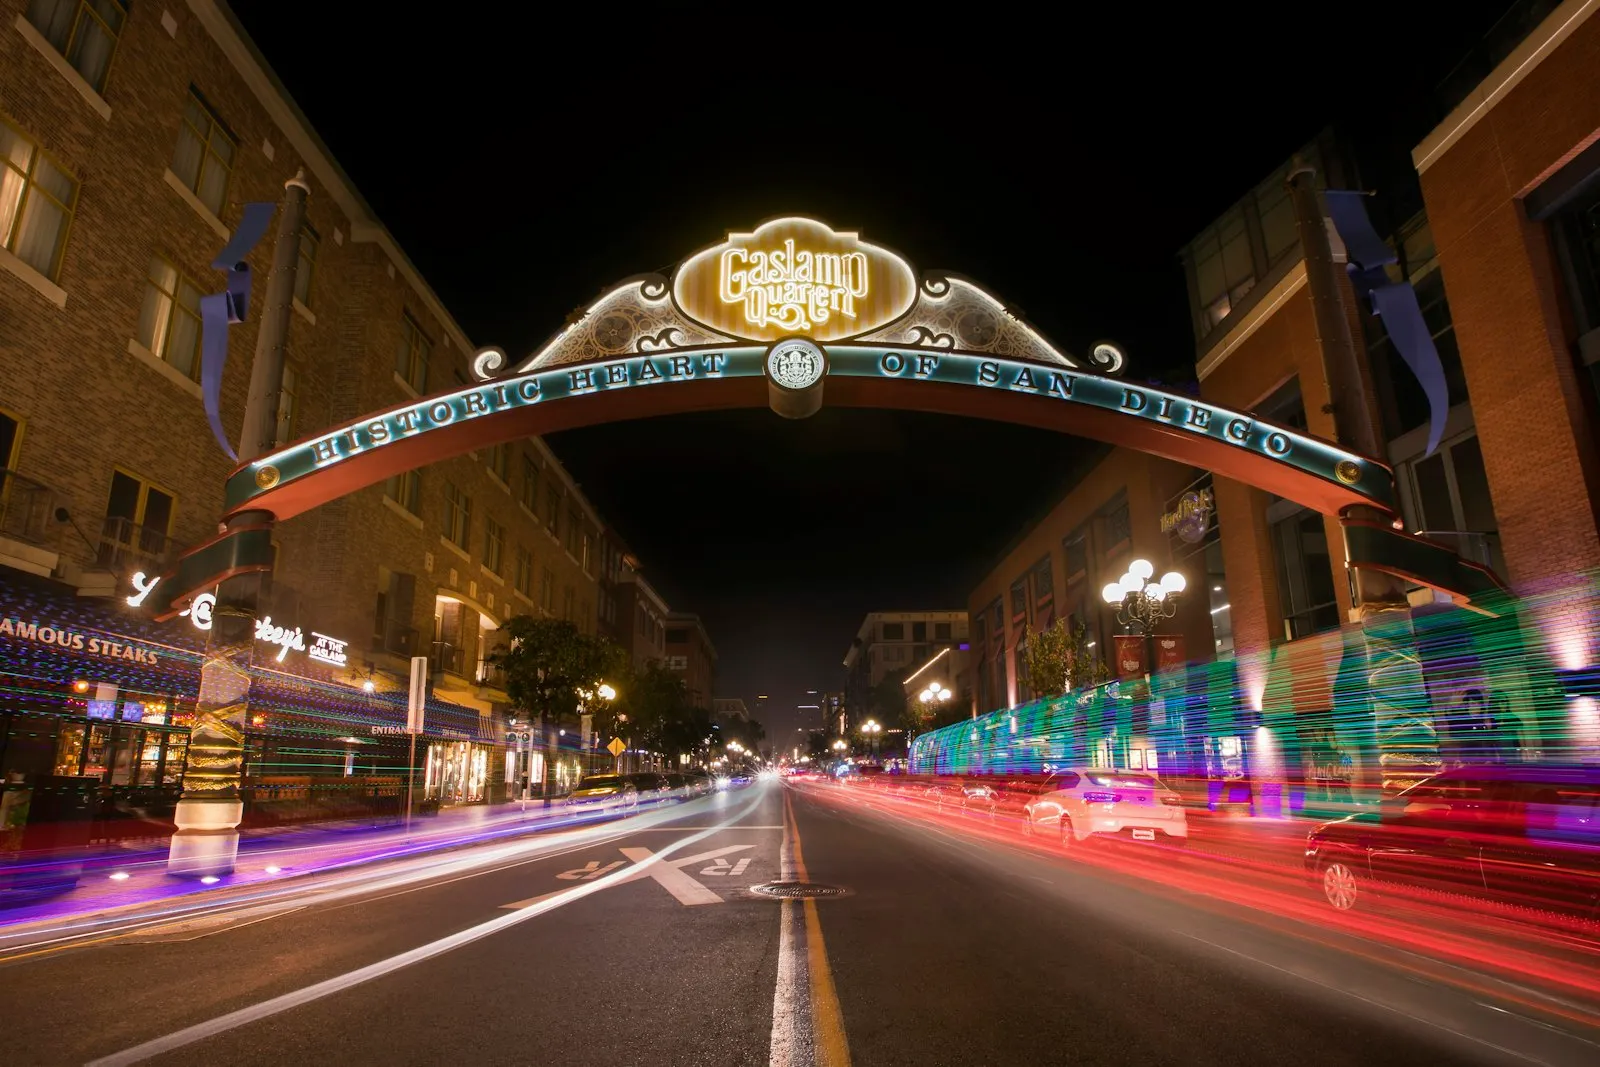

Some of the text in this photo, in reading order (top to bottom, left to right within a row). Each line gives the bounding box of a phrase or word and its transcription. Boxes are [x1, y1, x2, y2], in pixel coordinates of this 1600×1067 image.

[720, 239, 868, 303] Gaslamp
[744, 280, 857, 331] Quarter
[310, 378, 542, 466] HISTORIC
[568, 352, 728, 394] HEART
[881, 351, 939, 378] OF
[978, 360, 1079, 399] SAN
[1119, 387, 1293, 458] DIEGO
[88, 638, 158, 665] STEAKS
[309, 645, 347, 662] GASLAMP
[316, 638, 344, 653] AT THE
[371, 725, 418, 735] ENTRAN
